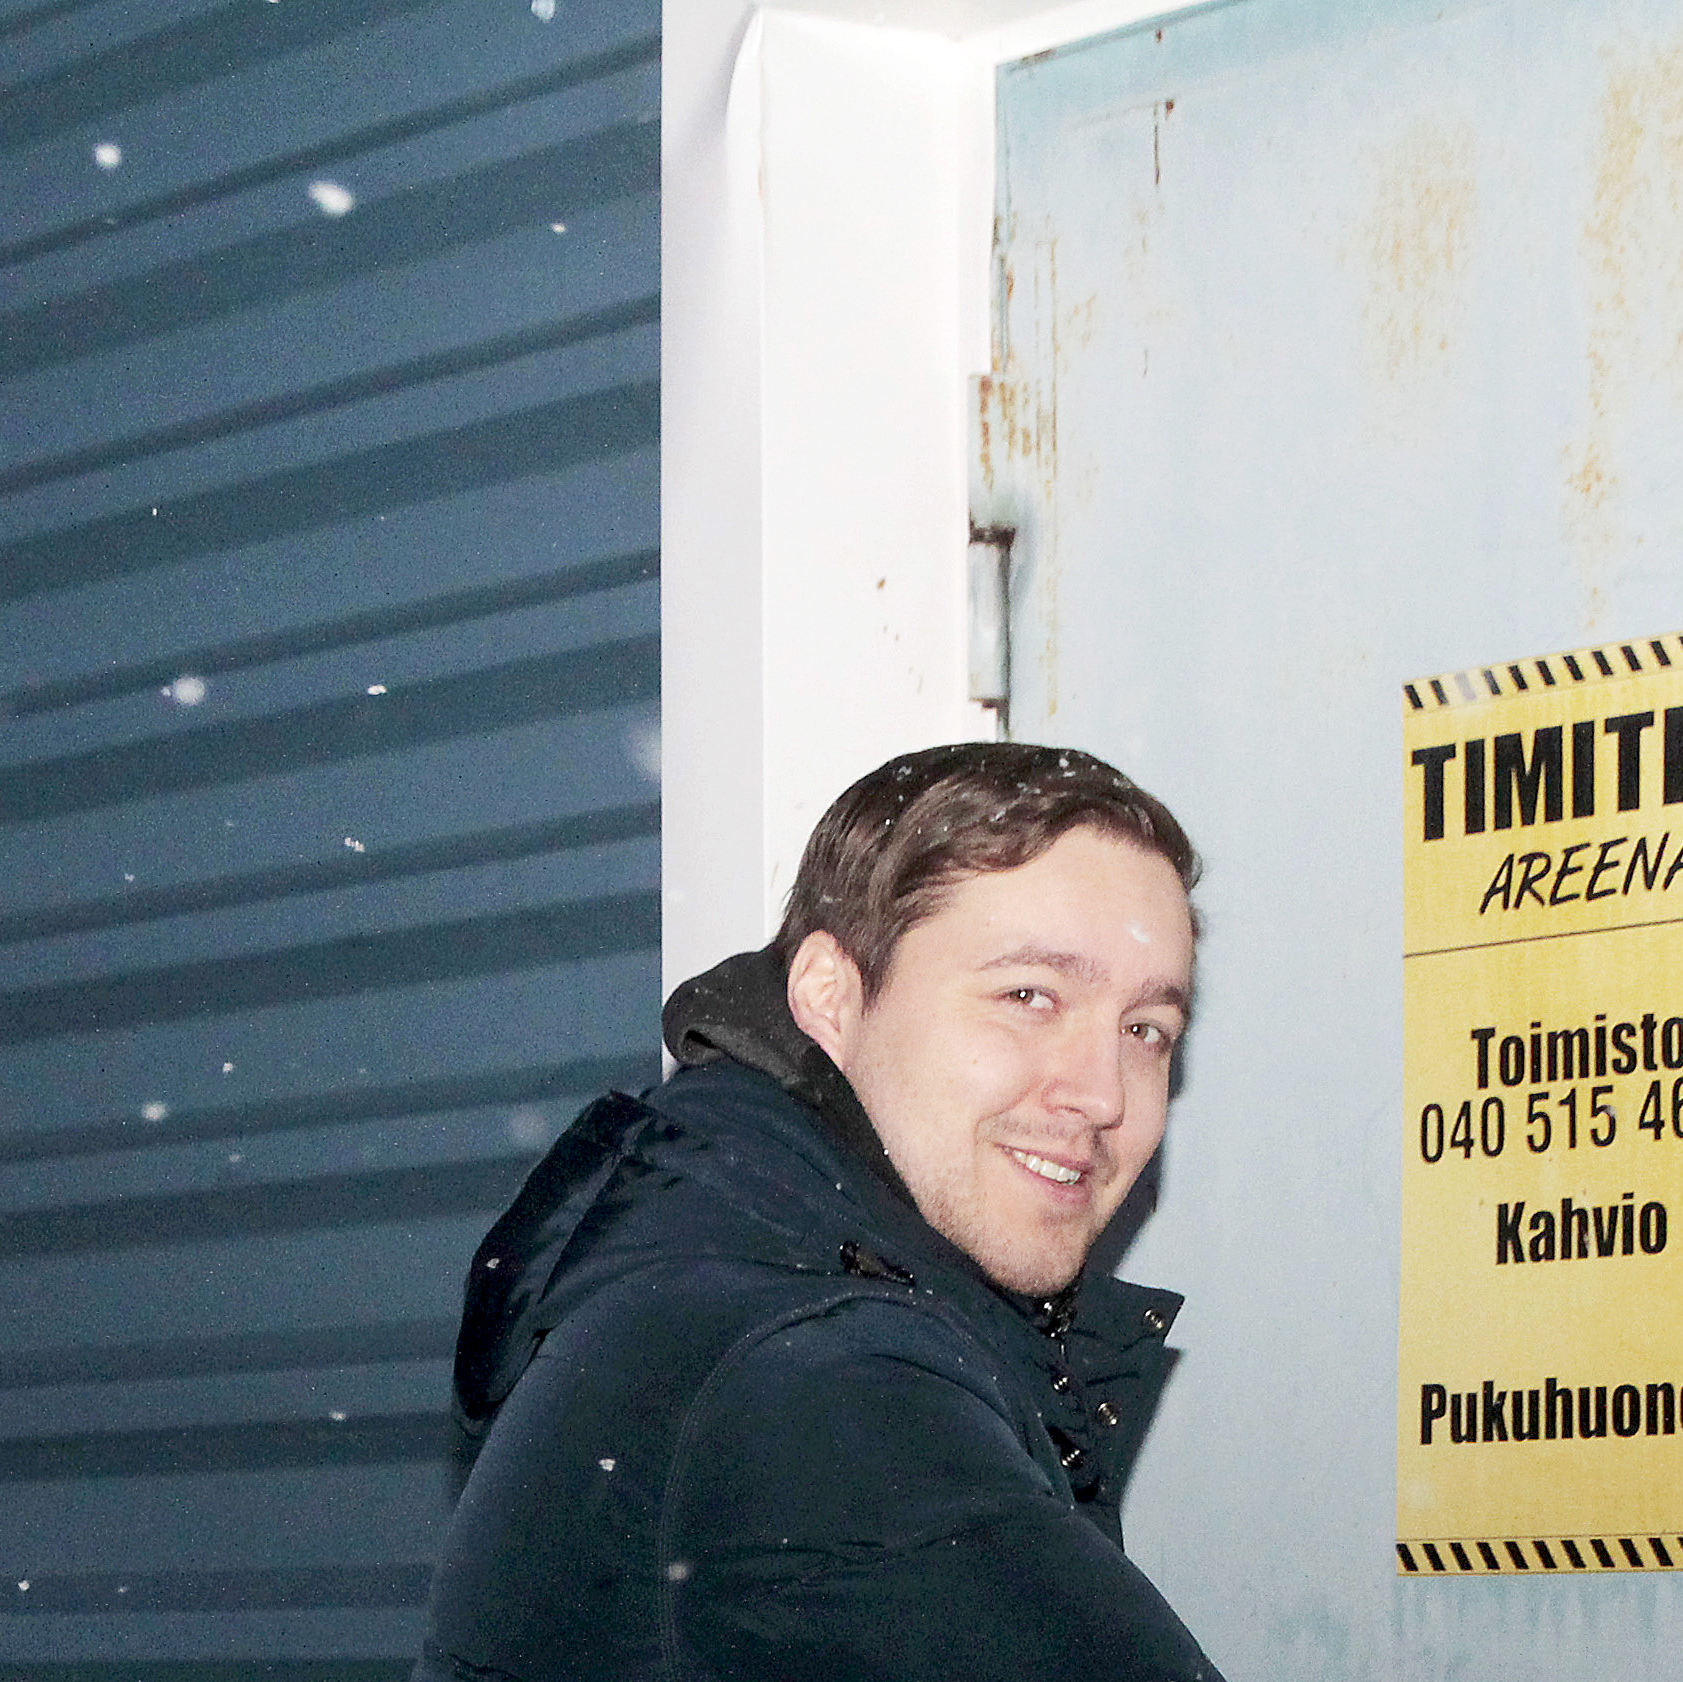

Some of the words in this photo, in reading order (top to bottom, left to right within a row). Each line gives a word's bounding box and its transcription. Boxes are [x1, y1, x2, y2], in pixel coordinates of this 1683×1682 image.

[1421, 1096, 1505, 1163] 040
[1527, 1085, 1616, 1153] 515
[1496, 1192, 1668, 1264] Kahvio
